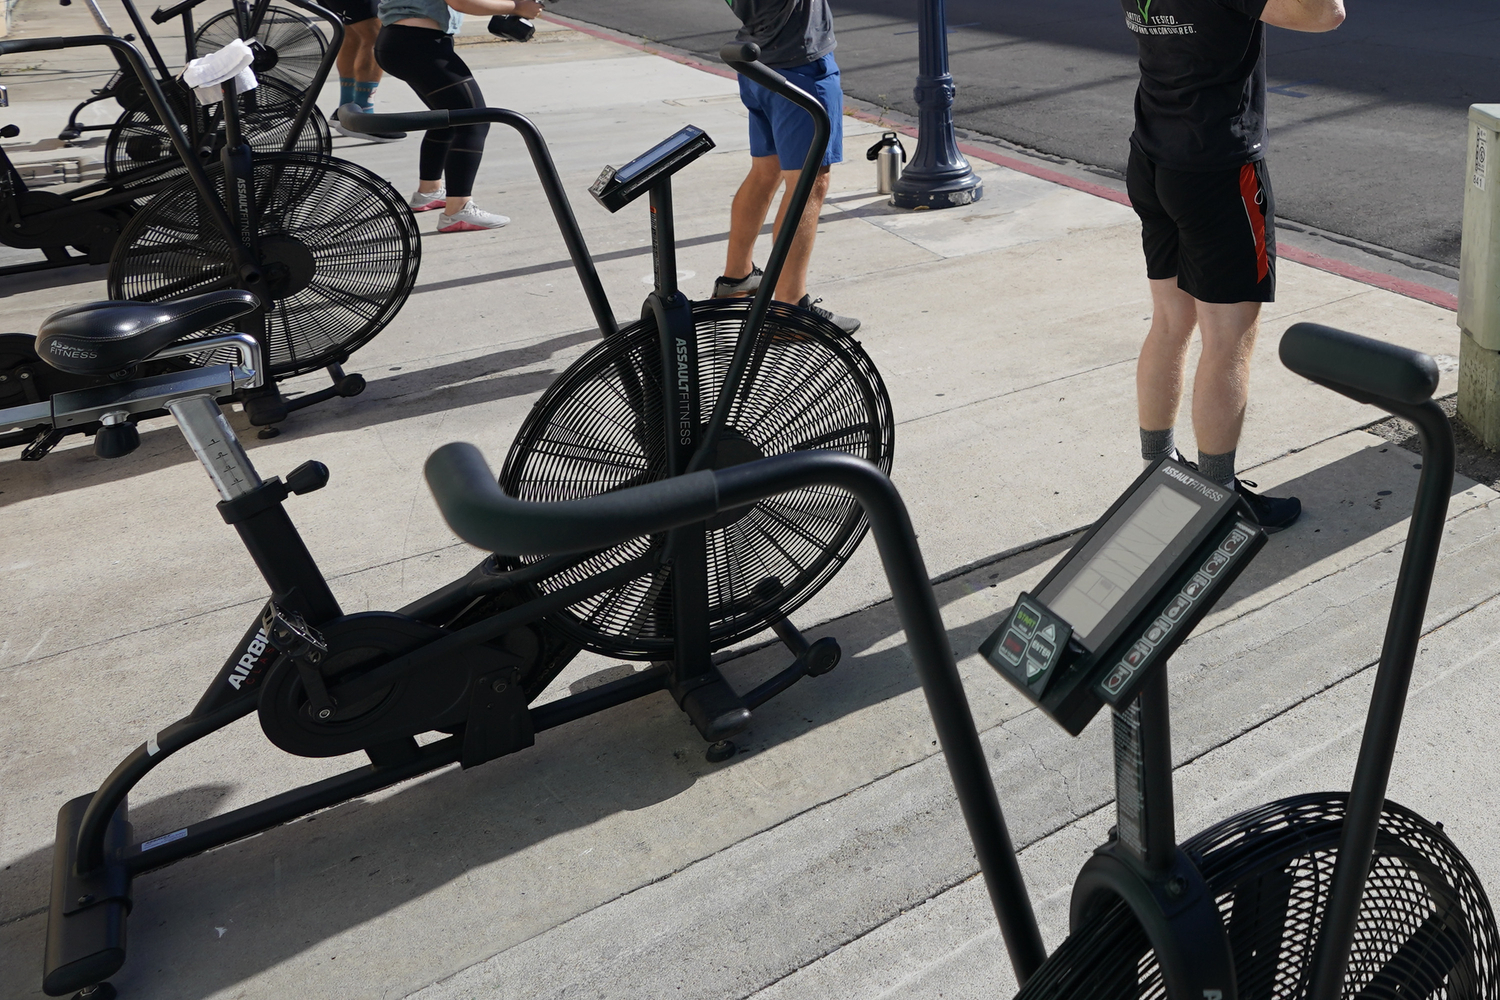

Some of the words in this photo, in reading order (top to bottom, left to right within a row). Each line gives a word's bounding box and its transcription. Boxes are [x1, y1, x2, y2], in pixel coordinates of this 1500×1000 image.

[1151, 15, 1179, 25] TESTED.
[50, 347, 98, 359] FITNESS
[675, 337, 691, 446] ASSAULTFITNESS
[1162, 466, 1223, 502] ASSAULTFITNESS
[1017, 610, 1036, 628] START
[1031, 639, 1052, 660] ENTER
